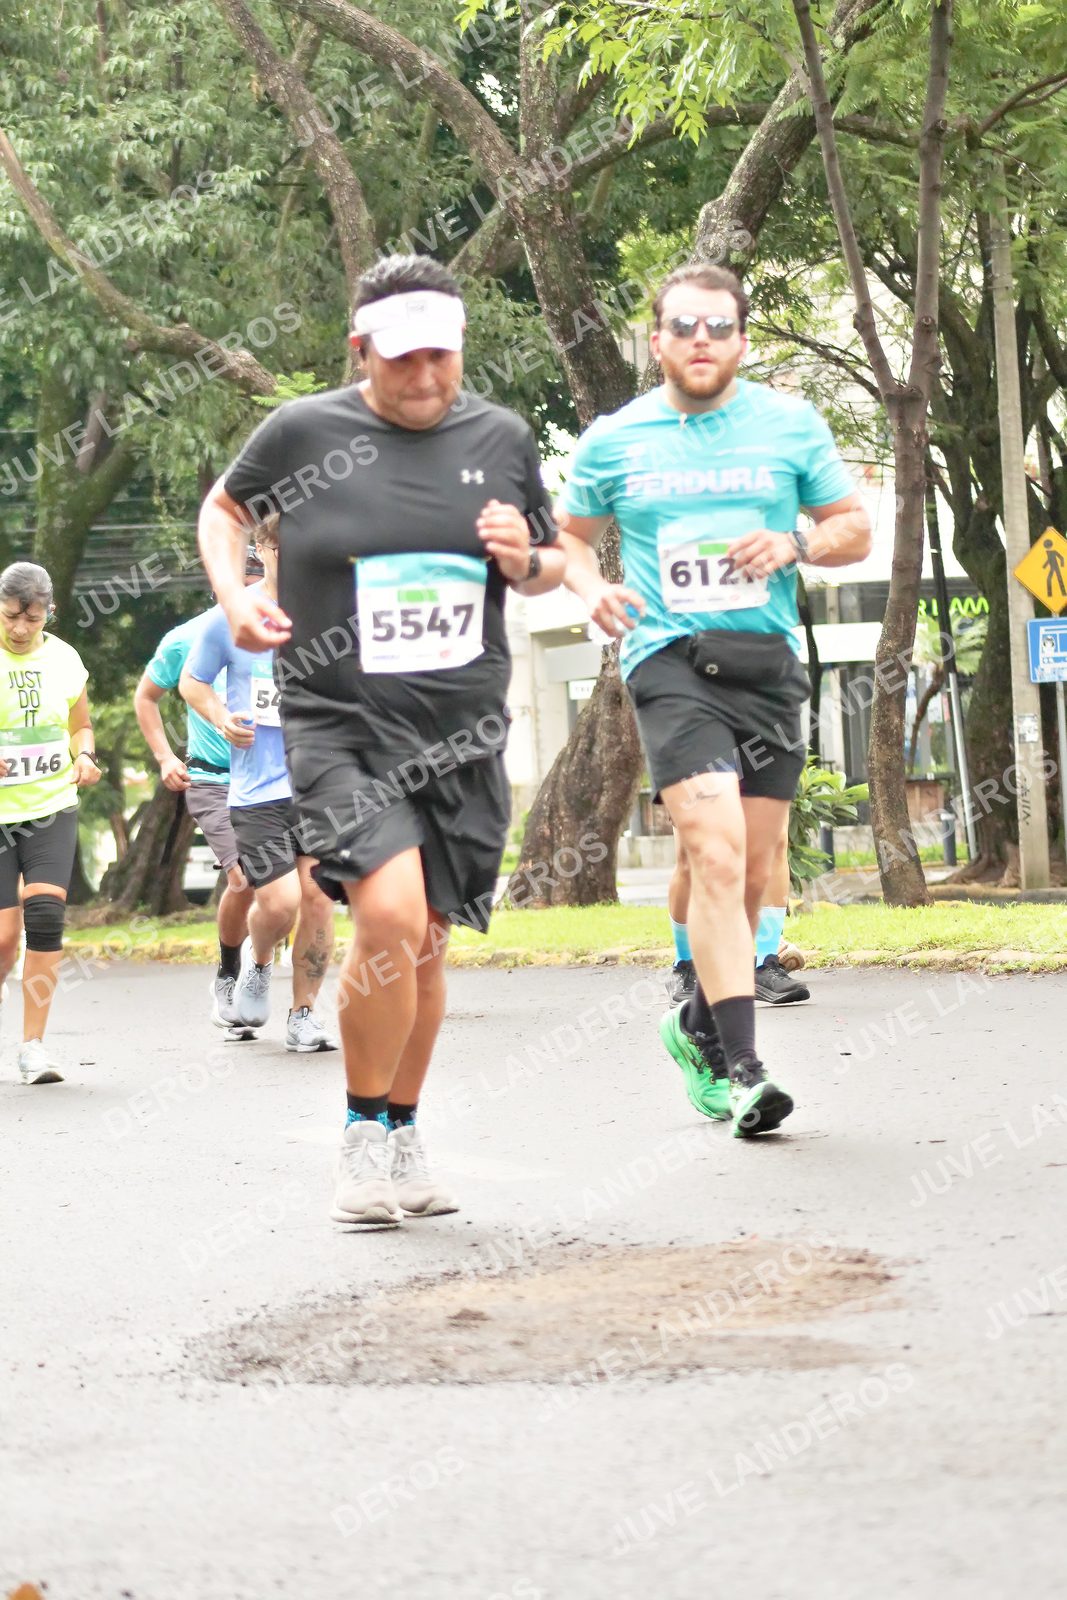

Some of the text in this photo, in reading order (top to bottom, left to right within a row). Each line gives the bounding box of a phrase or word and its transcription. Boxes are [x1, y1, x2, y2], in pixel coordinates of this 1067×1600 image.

[669, 557, 756, 588] 612
[372, 603, 475, 642] 5547
[9, 670, 42, 689] JUST
[19, 689, 41, 709] DO
[24, 709, 38, 728] IT
[5, 753, 62, 778] 2146
